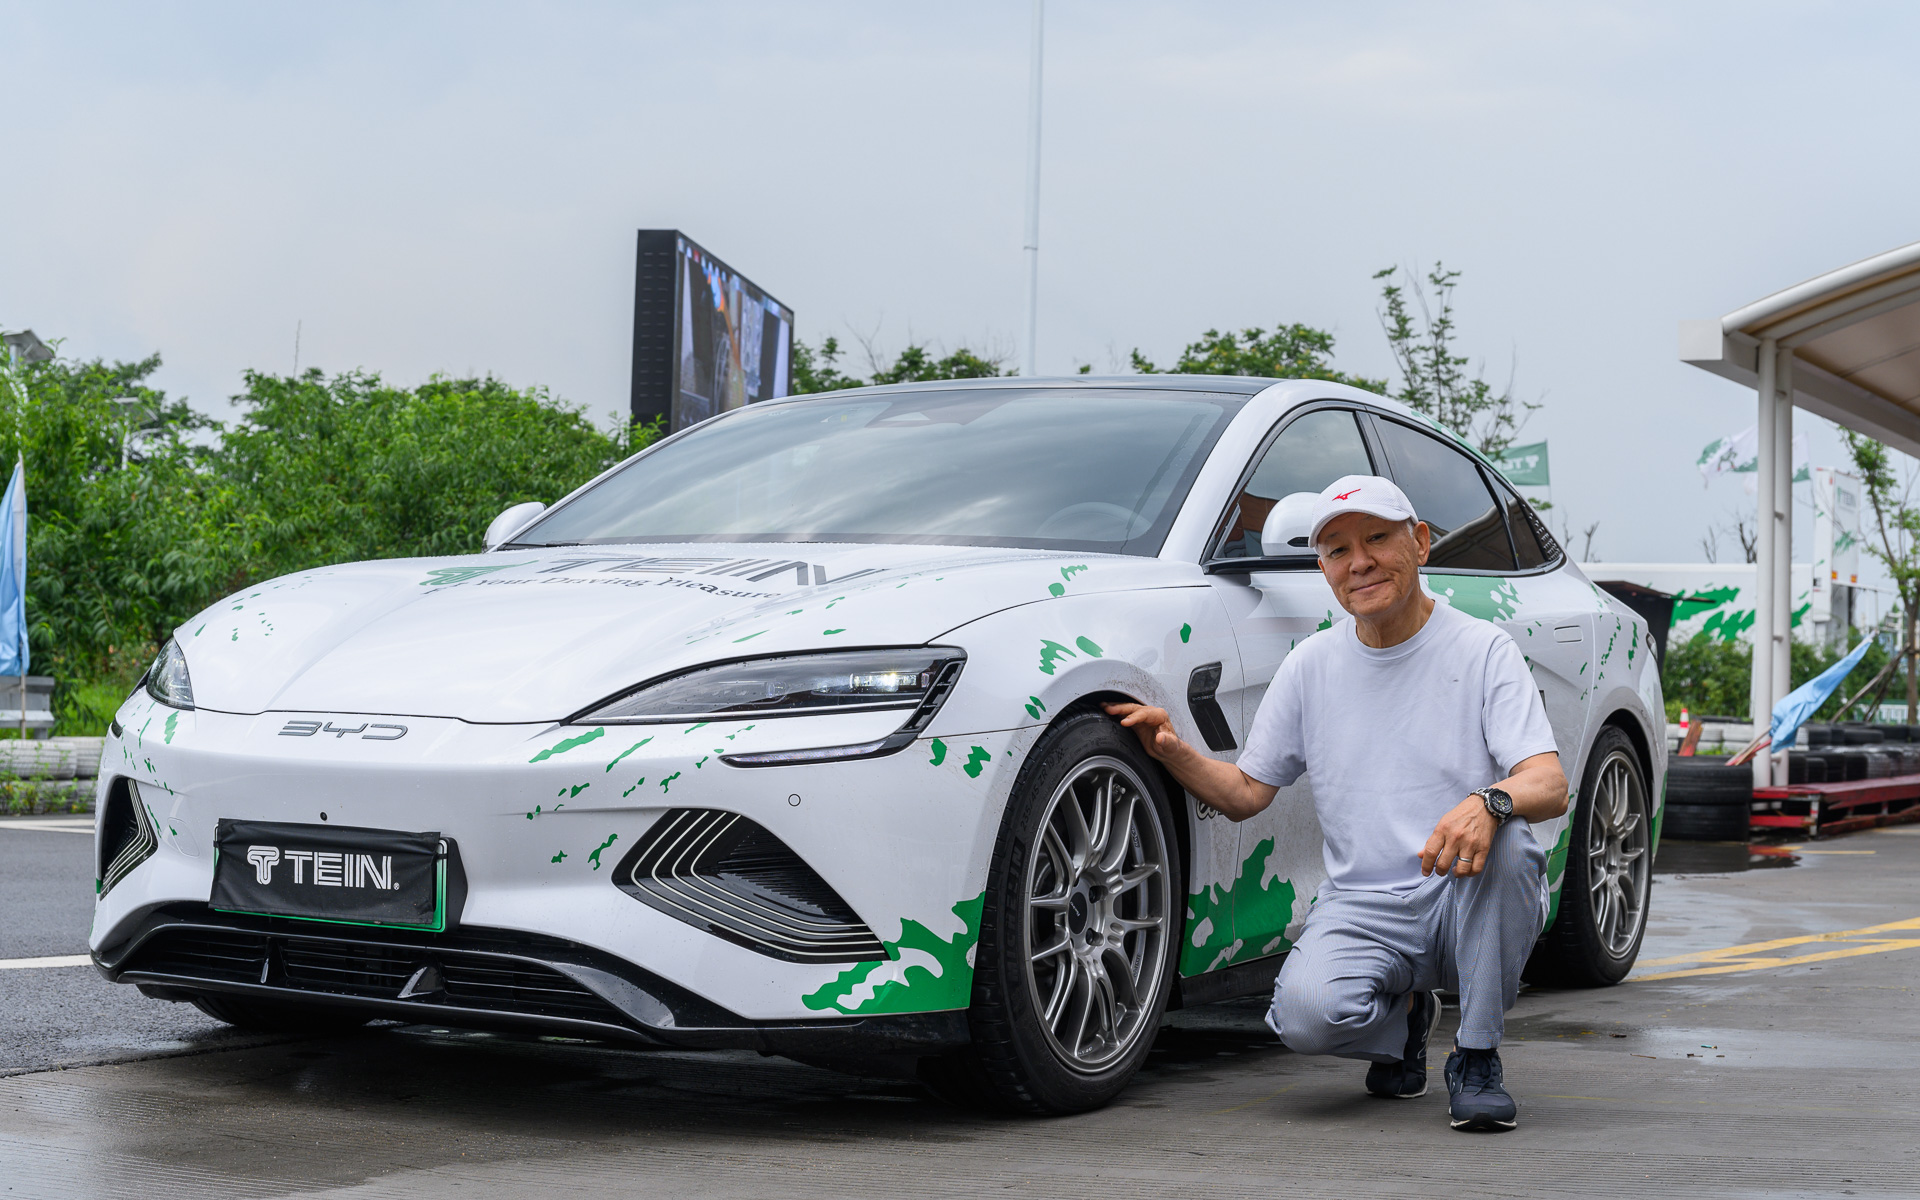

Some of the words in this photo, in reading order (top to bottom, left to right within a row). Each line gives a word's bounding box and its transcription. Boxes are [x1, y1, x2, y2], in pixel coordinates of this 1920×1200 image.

[537, 558, 890, 585] TEIN
[475, 578, 536, 586] Your
[542, 577, 652, 587] Driving
[657, 576, 781, 597] Pleasure
[278, 720, 408, 740] BYD
[1005, 842, 1024, 982] MICHELIN
